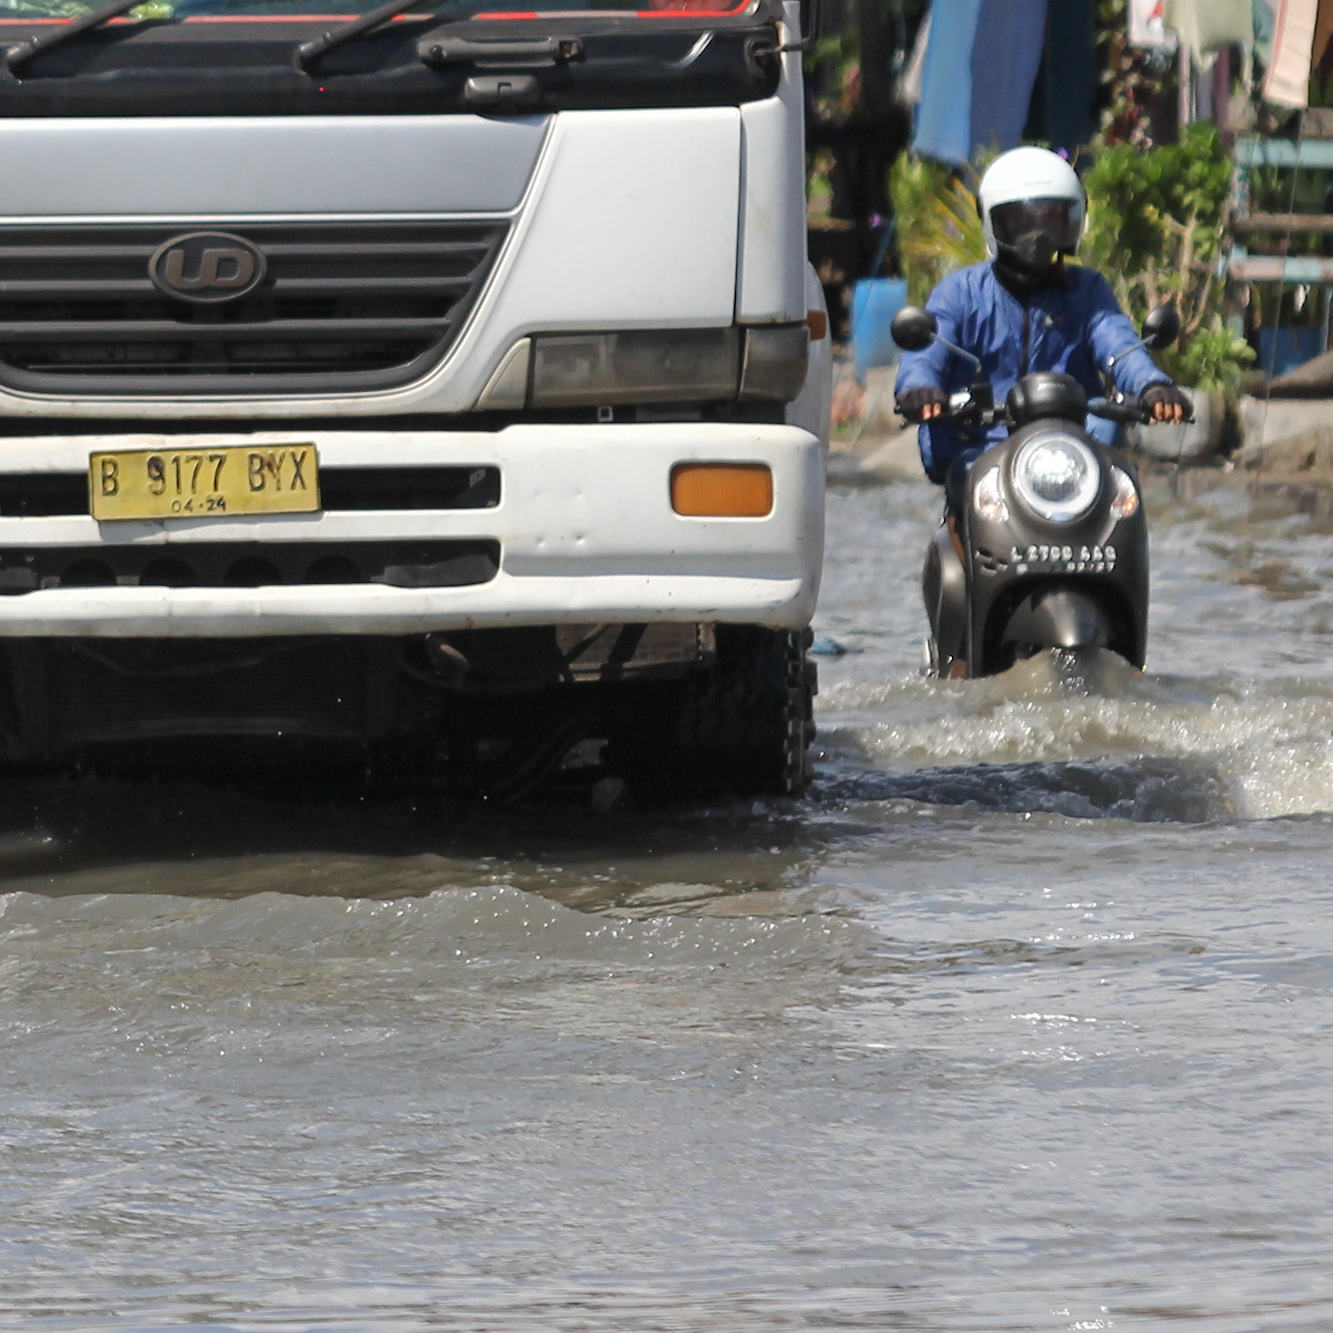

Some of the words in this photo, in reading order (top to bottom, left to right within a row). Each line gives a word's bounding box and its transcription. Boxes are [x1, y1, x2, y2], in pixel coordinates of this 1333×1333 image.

[166, 248, 254, 288] UD
[101, 456, 119, 496] B
[146, 454, 228, 496] 9177
[247, 450, 309, 492] BYX
[1011, 546, 1023, 562] L
